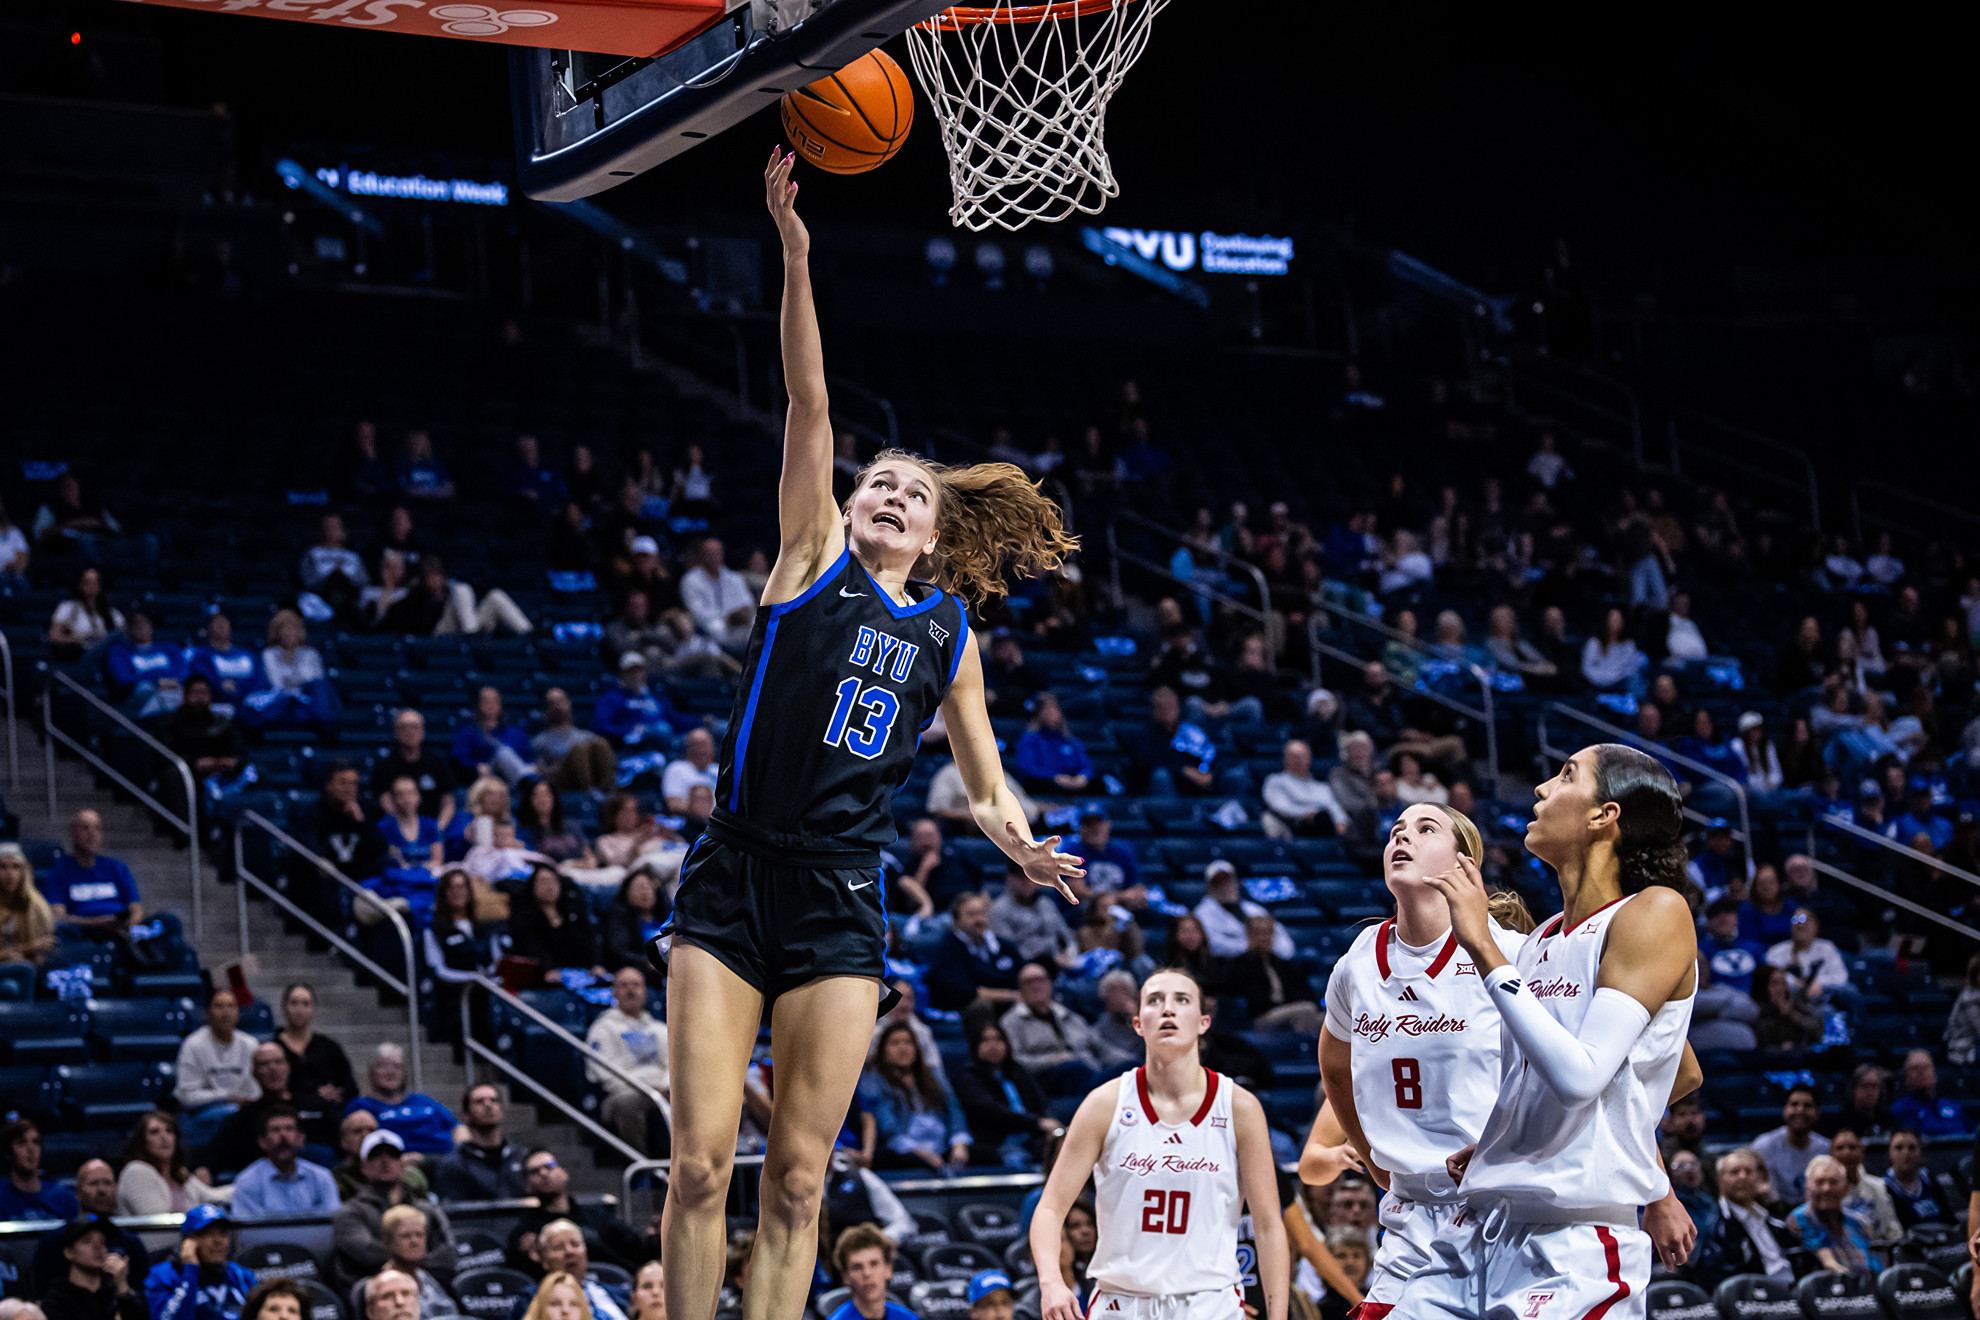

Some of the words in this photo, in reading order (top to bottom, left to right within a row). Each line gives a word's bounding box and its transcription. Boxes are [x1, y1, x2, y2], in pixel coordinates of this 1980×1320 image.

[187, 0, 427, 26] Stat
[348, 170, 449, 201] Education
[450, 179, 508, 206] Week
[849, 625, 919, 683] BYU
[823, 676, 900, 760] 13
[1354, 1013, 1392, 1043] Lady
[1395, 1013, 1468, 1036] Raiders
[1391, 1058, 1423, 1109] 8
[1119, 1152, 1158, 1176] Lady
[1161, 1154, 1220, 1173] Raiders
[1141, 1189, 1191, 1235] 20
